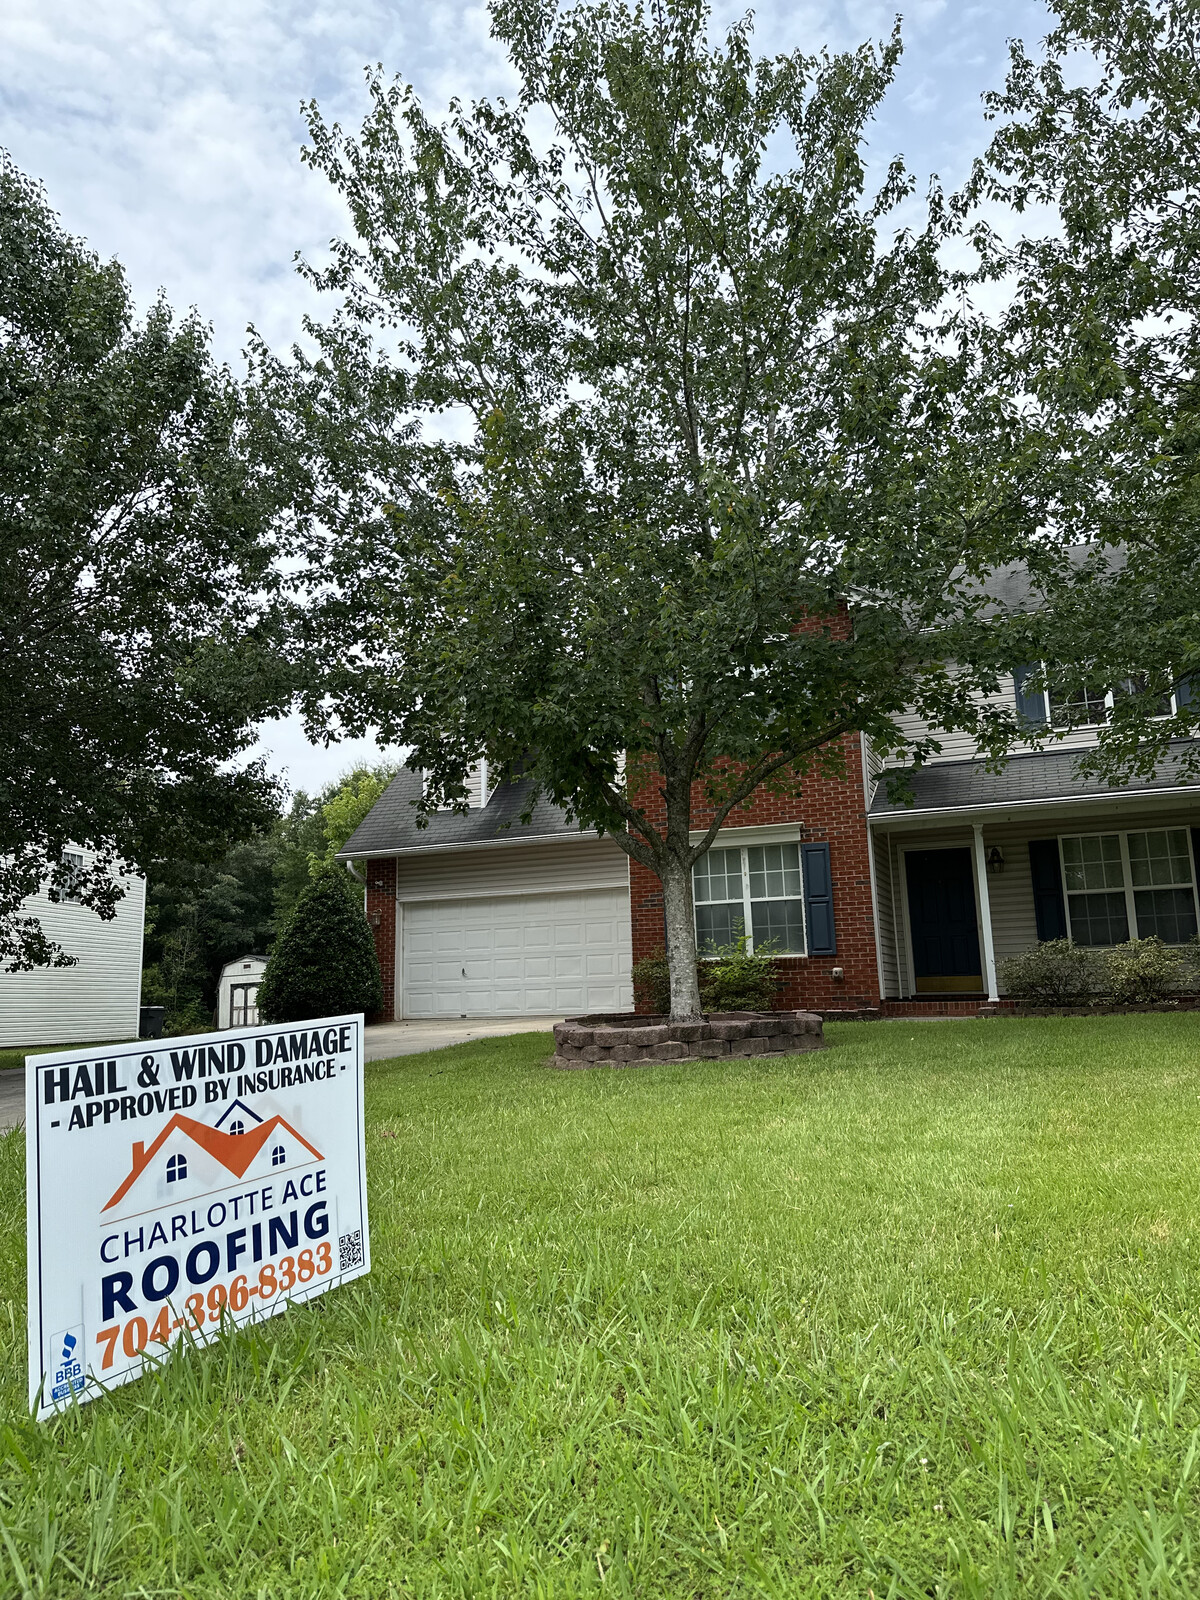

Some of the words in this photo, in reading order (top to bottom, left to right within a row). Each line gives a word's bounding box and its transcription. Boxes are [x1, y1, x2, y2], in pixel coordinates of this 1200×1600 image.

[44, 1061, 127, 1105] HAIL
[137, 1055, 160, 1088] &
[169, 1042, 246, 1082] WIND
[255, 1027, 351, 1068] DAMAGE
[68, 1085, 197, 1132] APPROVED
[204, 1078, 231, 1104] BY
[237, 1058, 336, 1096] INSURANCE
[100, 1186, 273, 1263] CHARLOTTE
[282, 1170, 327, 1204] ACE
[101, 1200, 330, 1322] ROOFING
[96, 1241, 333, 1371] 704-396-8383
[55, 1364, 81, 1384] BBB
